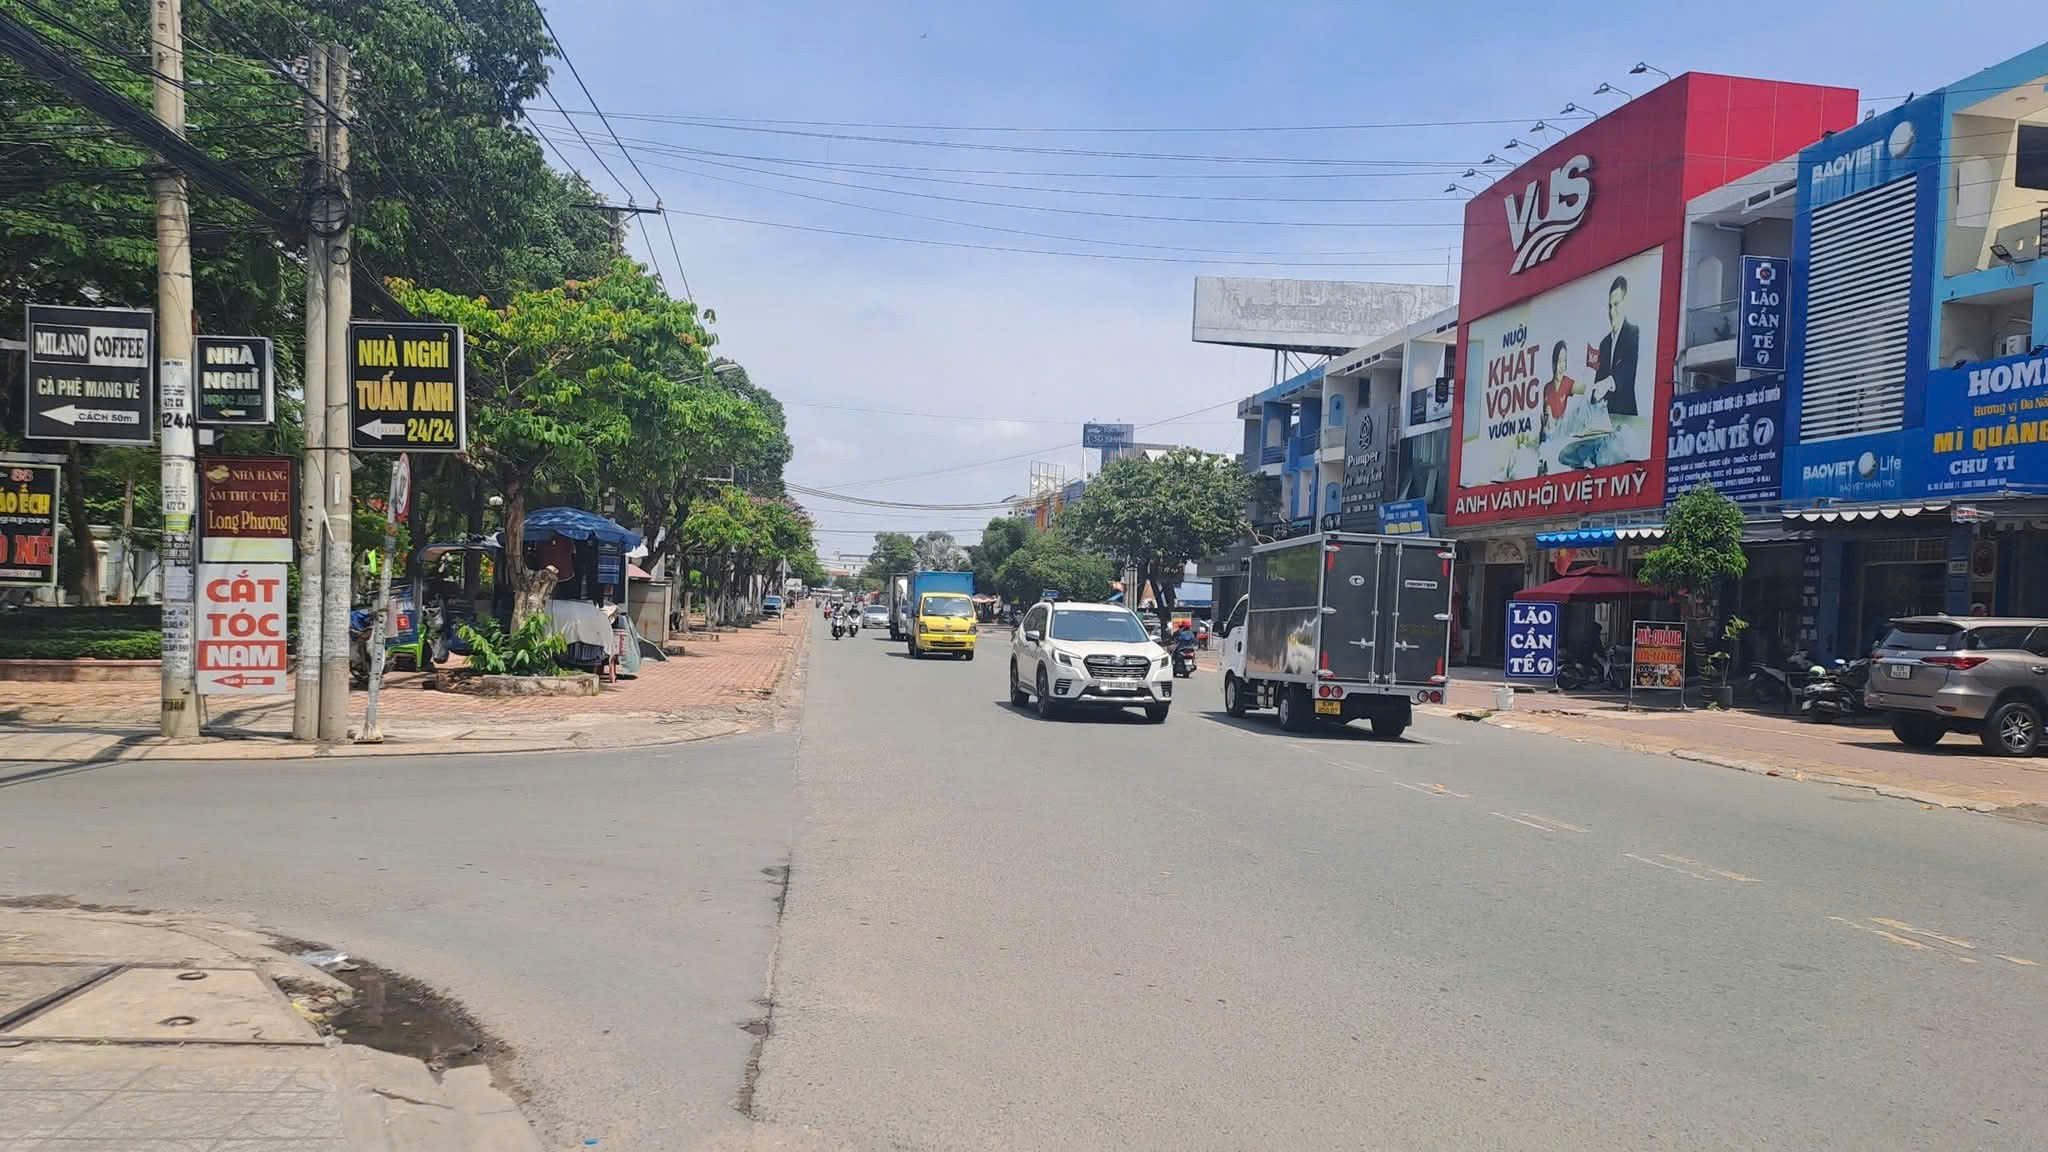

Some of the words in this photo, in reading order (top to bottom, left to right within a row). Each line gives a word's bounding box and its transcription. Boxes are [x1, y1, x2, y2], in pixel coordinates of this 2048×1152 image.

[1811, 139, 1885, 185] BAOVIET
[1503, 154, 1590, 253] VUS
[1750, 288, 1780, 306] LÃO
[35, 331, 88, 357] MILANO
[94, 336, 144, 359] COFFEE
[1502, 324, 1528, 349] NUÔI
[1752, 330, 1775, 349] TẾ
[206, 344, 256, 365] NHÀ
[358, 334, 398, 367] NHÀ
[403, 332, 449, 368] NGHỈ
[1757, 350, 1770, 365] 7
[1488, 342, 1540, 388] KHÁT
[1967, 357, 2048, 397] HOM
[57, 377, 83, 397] PHÊ
[84, 381, 122, 398] MANG
[203, 367, 260, 390] NGHỈ
[356, 370, 408, 411] TUẤN
[412, 381, 454, 412] ANH
[1486, 378, 1540, 419] VỌNG
[79, 411, 108, 421] CÁCH
[111, 414, 133, 422] 50m
[162, 412, 193, 429] 124A
[1488, 419, 1516, 440] VƯƠN
[1517, 416, 1533, 433] XA
[407, 418, 455, 442] 24/24
[1668, 429, 1695, 459] LÃO
[1728, 413, 1750, 449] TẾ
[1753, 417, 1775, 446] 7
[232, 468, 255, 481] NHÀ
[257, 469, 287, 481] HÀNG
[1803, 460, 1856, 481] BAOVIET
[1880, 455, 1902, 472] Life
[1949, 453, 1988, 475] CHÚ
[1994, 449, 2015, 472] TÍ
[1455, 496, 1488, 515] ANH
[1490, 486, 1527, 510] VĂN
[1527, 481, 1558, 511] HỘI
[1561, 474, 1608, 505] VIỆT
[1610, 467, 1649, 498] MỸ
[208, 510, 240, 535] Long
[240, 510, 288, 535] Phượng
[206, 569, 280, 603] CẮT
[206, 608, 280, 637] TÓC
[1513, 606, 1552, 625] LÃO
[207, 645, 279, 667] NAM
[1509, 651, 1535, 673] TẾ
[1537, 657, 1554, 674] 7
